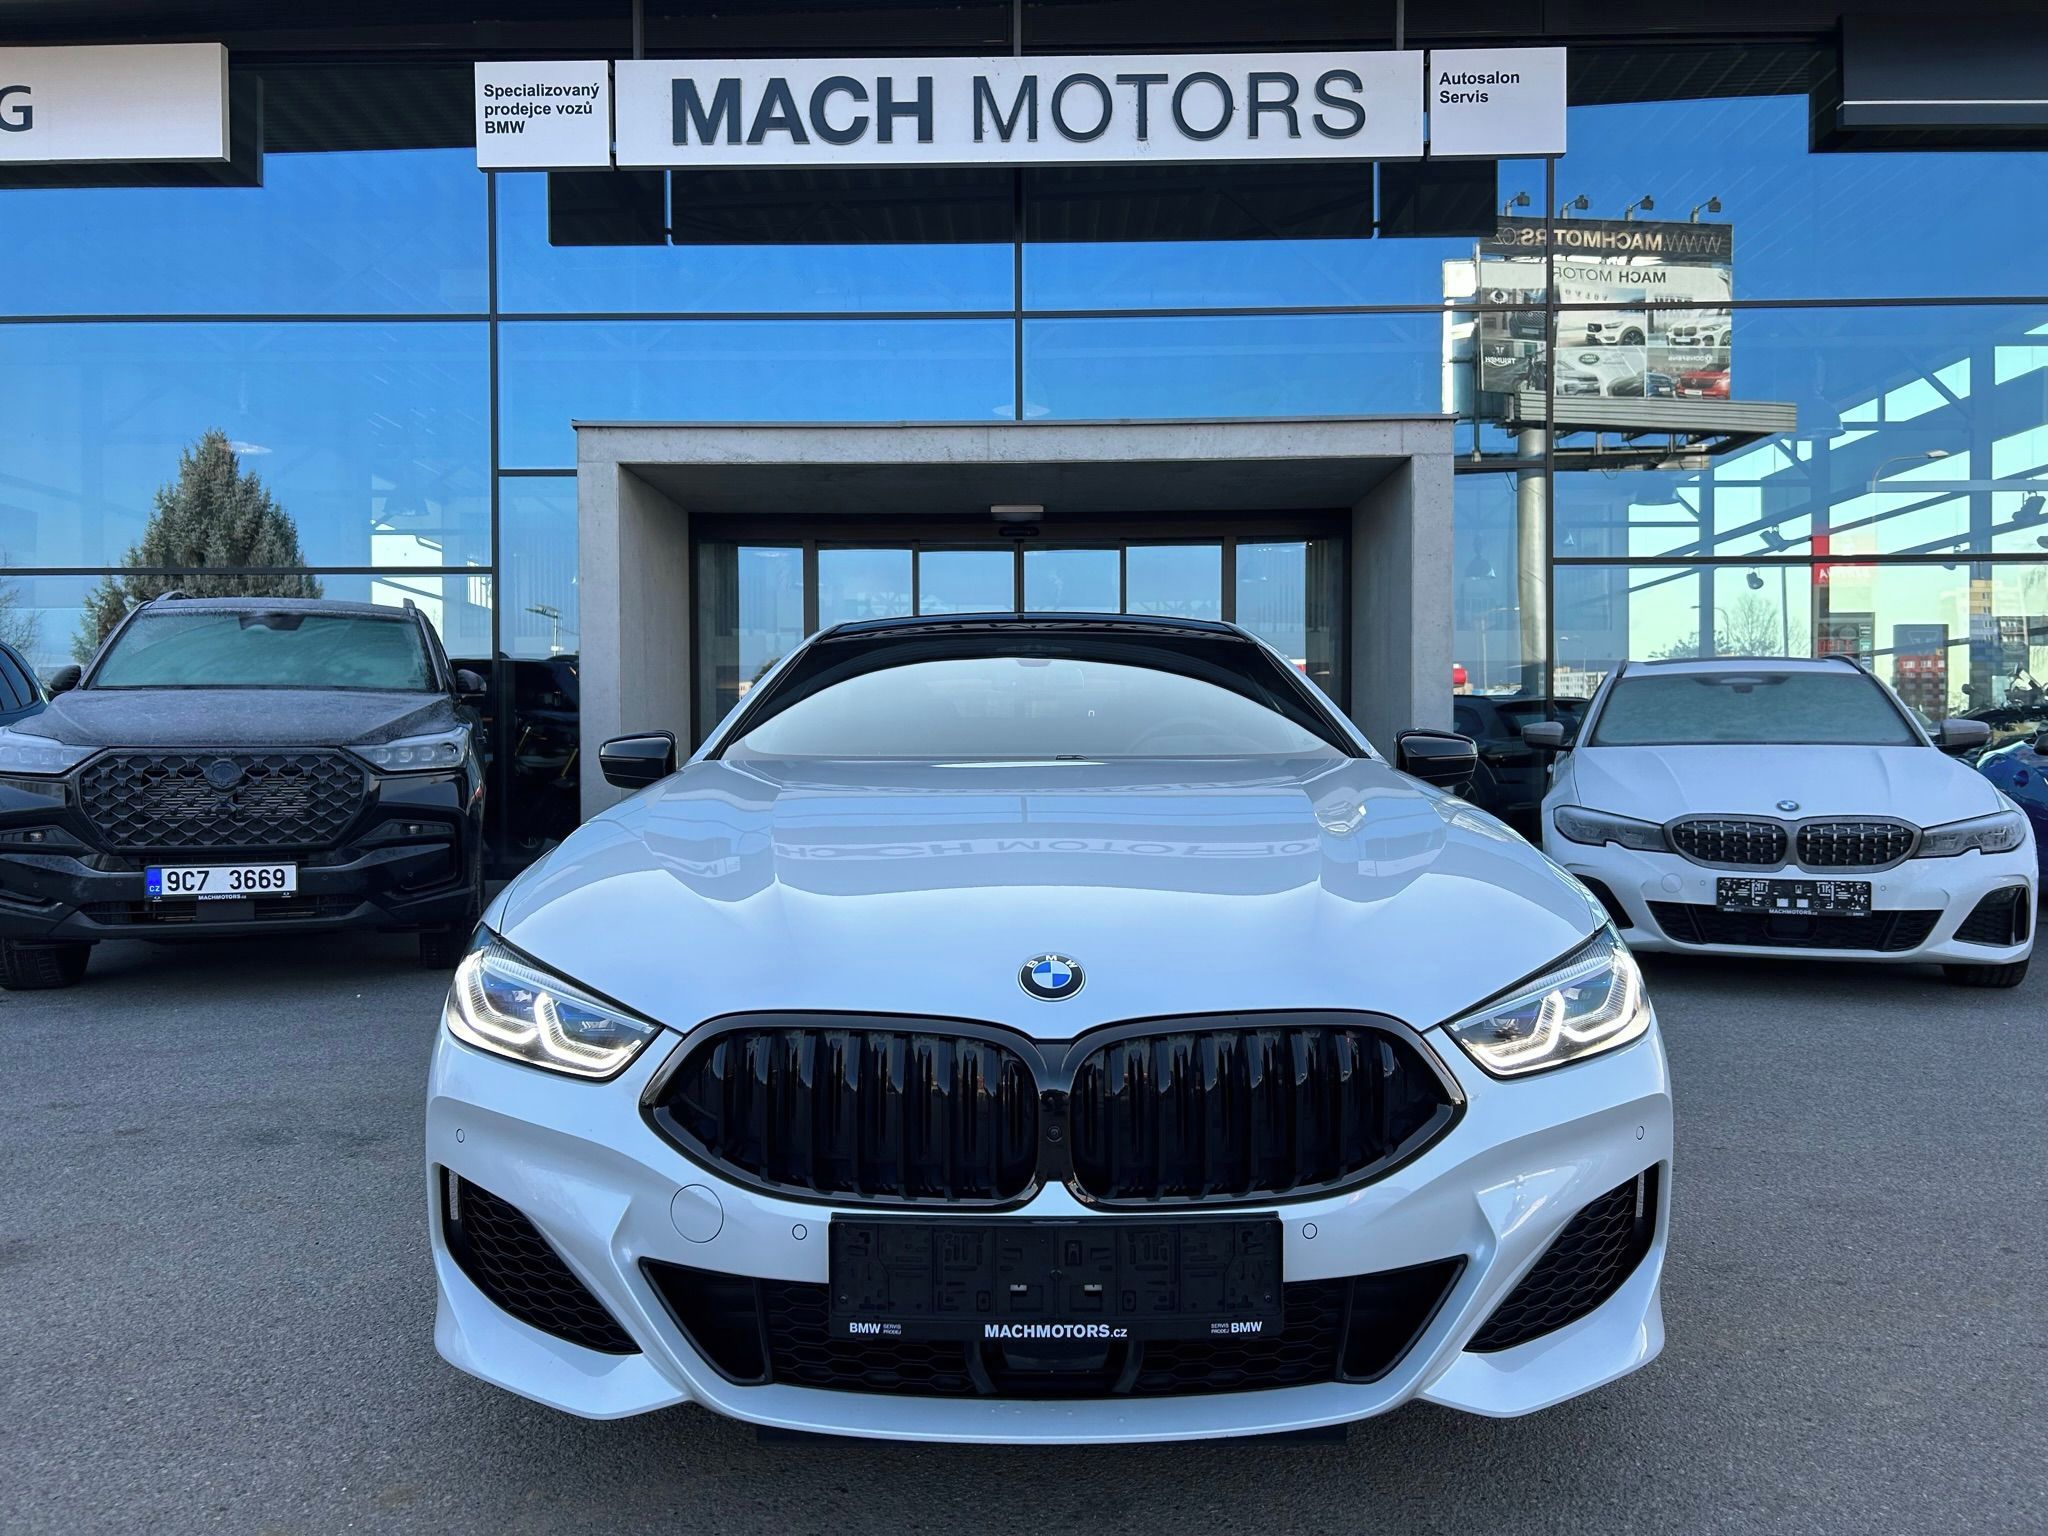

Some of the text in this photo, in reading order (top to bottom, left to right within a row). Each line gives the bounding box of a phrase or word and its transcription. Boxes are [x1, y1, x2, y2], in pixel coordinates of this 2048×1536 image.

[1439, 70, 1521, 85] Autosalon
[483, 82, 600, 100] Specializovaný
[1439, 89, 1489, 104] Servis
[484, 100, 593, 119] prodejce vozů
[671, 69, 1367, 146] MACH MOTORS
[485, 120, 526, 134] BMW
[166, 868, 286, 892] 9C7 3669
[1026, 954, 1079, 968] BMW
[849, 1322, 881, 1334] BMW
[984, 1323, 1128, 1339] MACHMOTORS.cz
[1231, 1320, 1263, 1333] BMW
